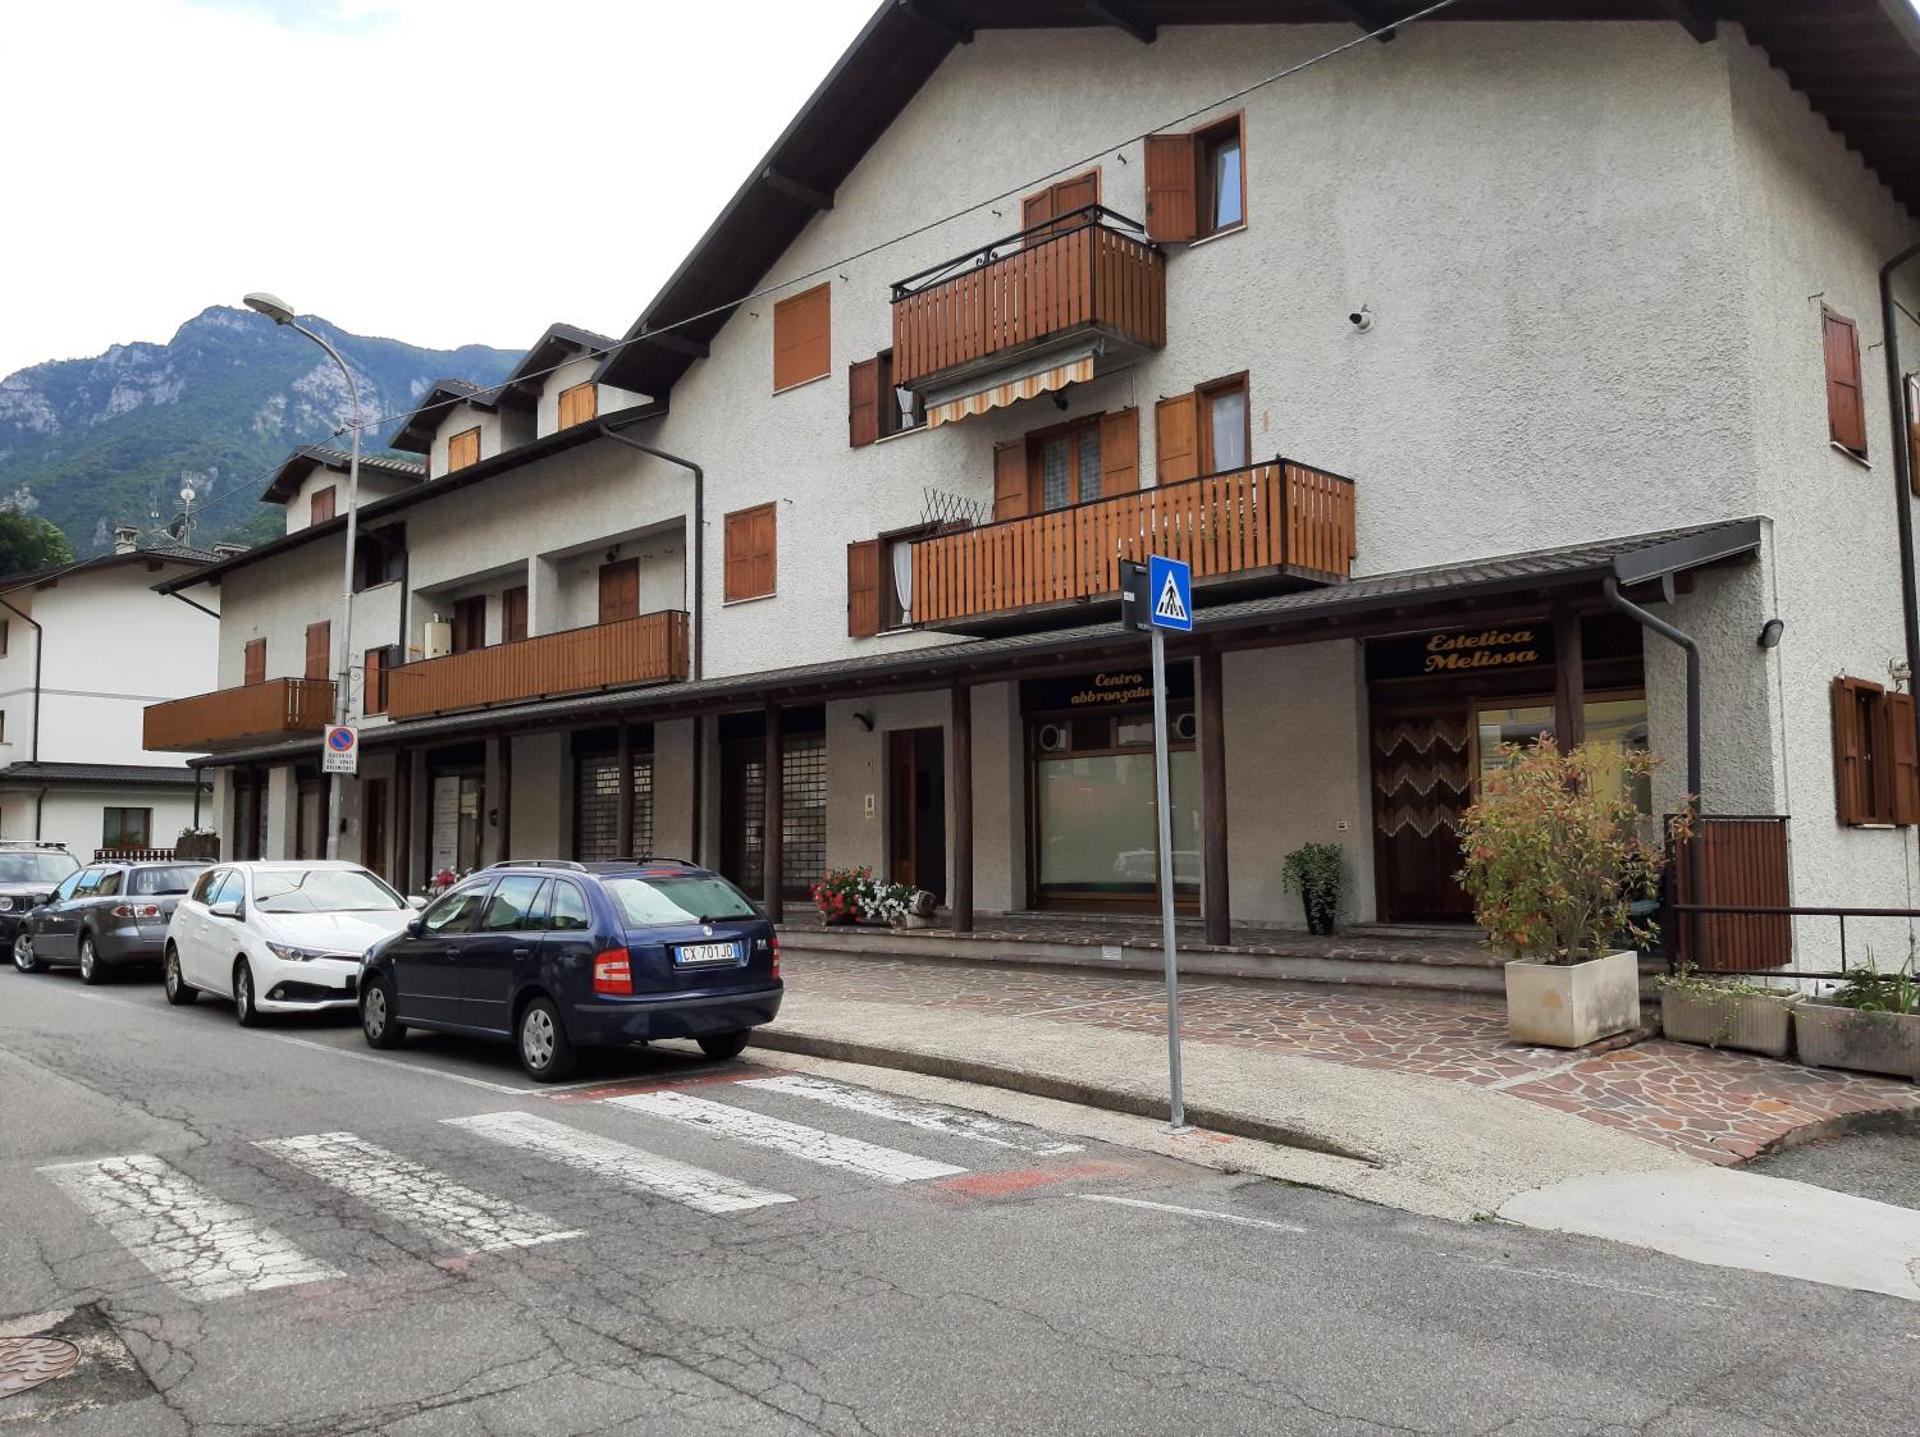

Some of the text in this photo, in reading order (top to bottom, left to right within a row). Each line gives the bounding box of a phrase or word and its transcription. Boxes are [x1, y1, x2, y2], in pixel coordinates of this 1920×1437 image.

[1426, 630, 1535, 652] Estetica
[1424, 650, 1537, 673] Melissa
[1095, 673, 1142, 687] Centro
[683, 946, 697, 961] CX
